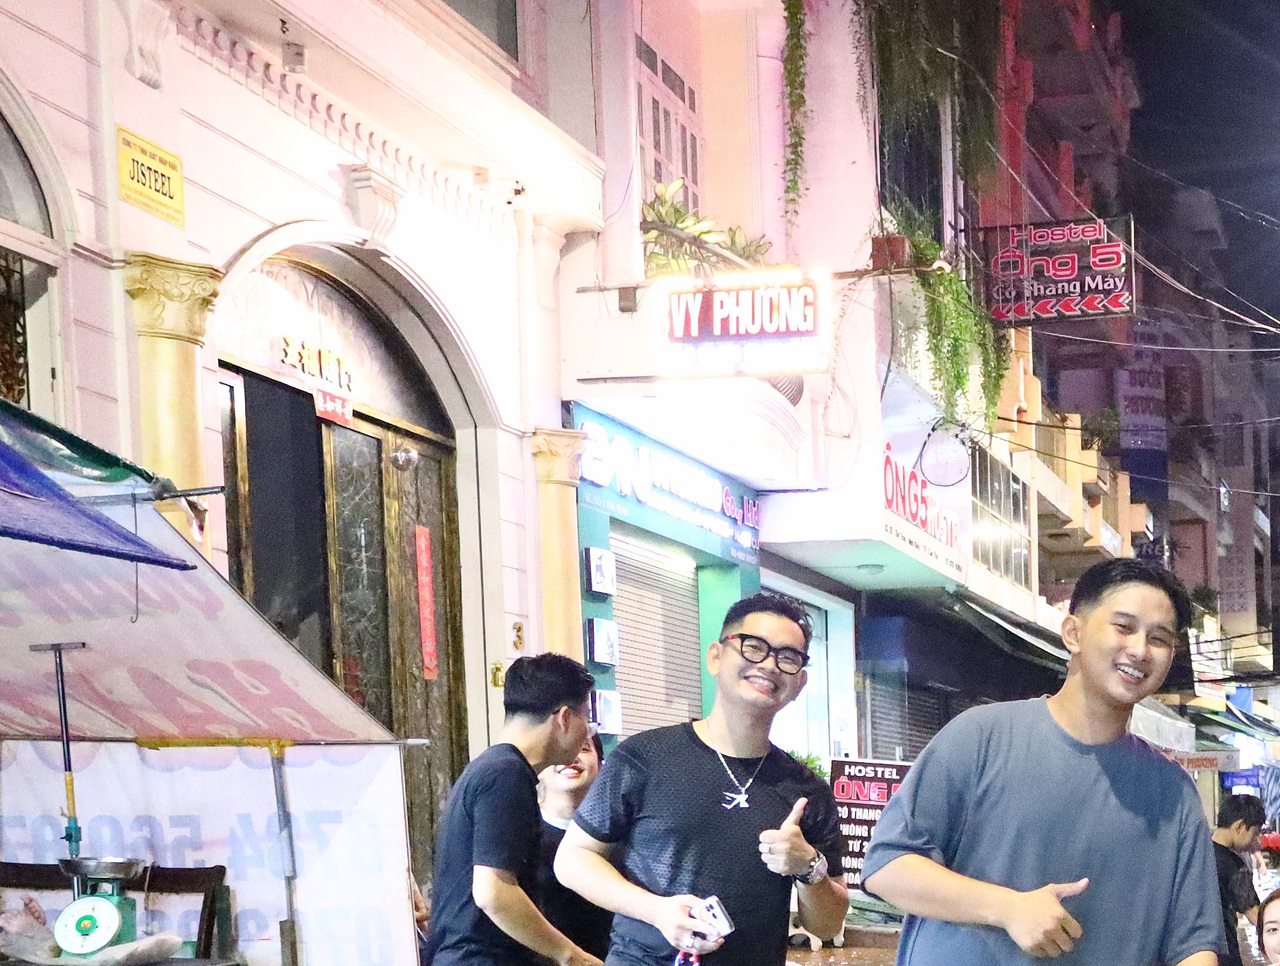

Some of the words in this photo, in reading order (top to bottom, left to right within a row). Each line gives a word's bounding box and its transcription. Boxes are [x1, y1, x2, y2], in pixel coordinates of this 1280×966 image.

[129, 158, 174, 200] JISTEEL
[1010, 219, 1103, 247] Hostel
[991, 247, 1078, 279] Ông
[1090, 242, 1123, 270] 5
[1084, 273, 1125, 294] Máy
[670, 292, 703, 339] VY
[844, 765, 900, 779] HOSTEL
[834, 775, 888, 801] ÔNG
[851, 807, 882, 821] THANG
